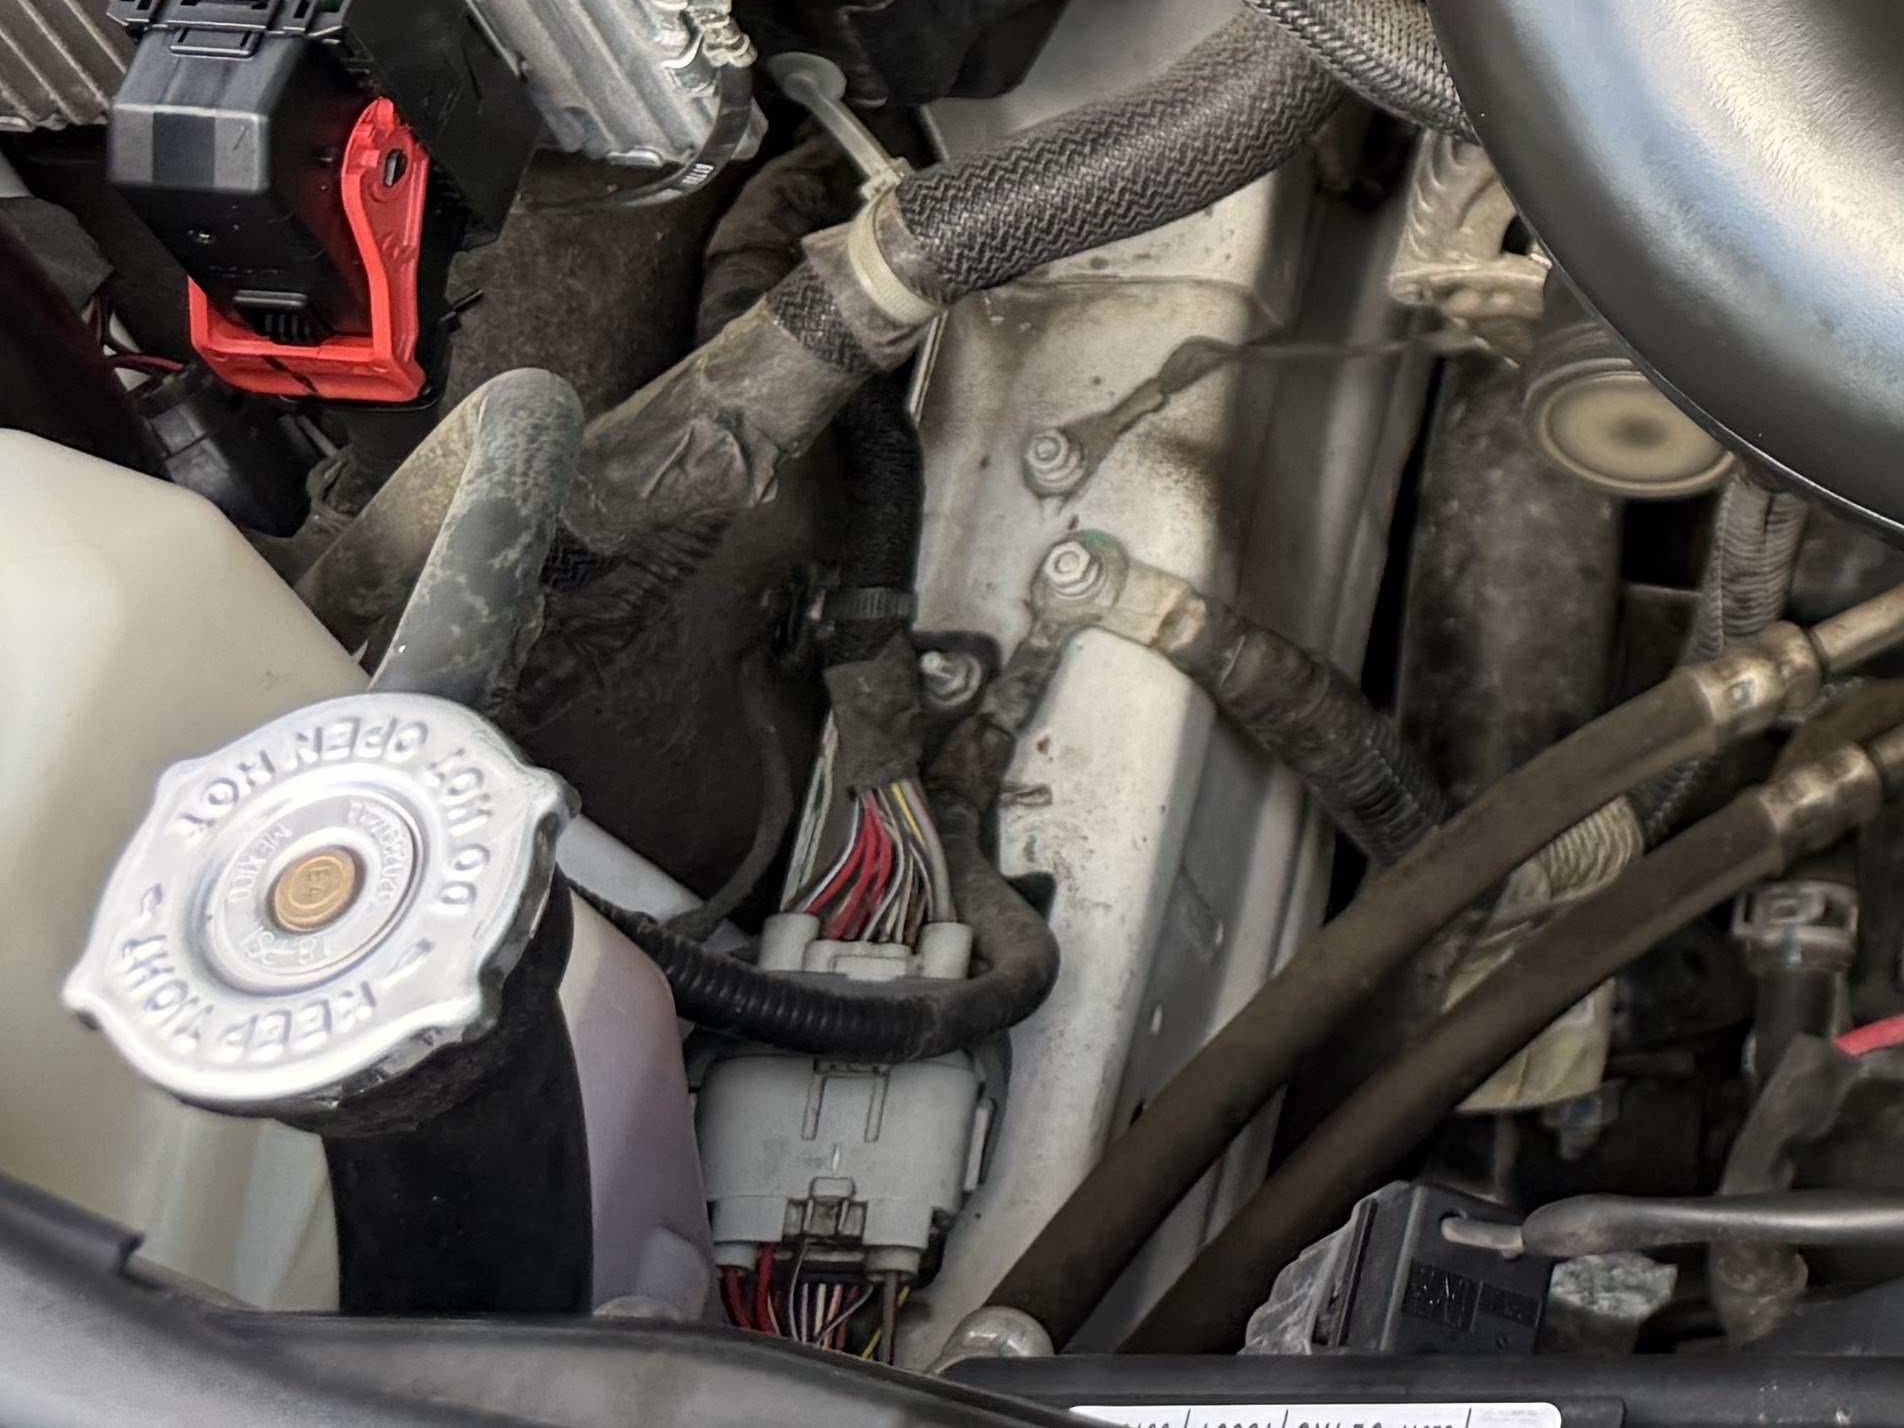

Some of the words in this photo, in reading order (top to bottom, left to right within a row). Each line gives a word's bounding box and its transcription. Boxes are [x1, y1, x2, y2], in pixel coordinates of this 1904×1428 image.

[283, 714, 430, 772] OPEN
[179, 748, 278, 842] HOT
[424, 747, 494, 836] NOT
[222, 979, 377, 1061] KEEP
